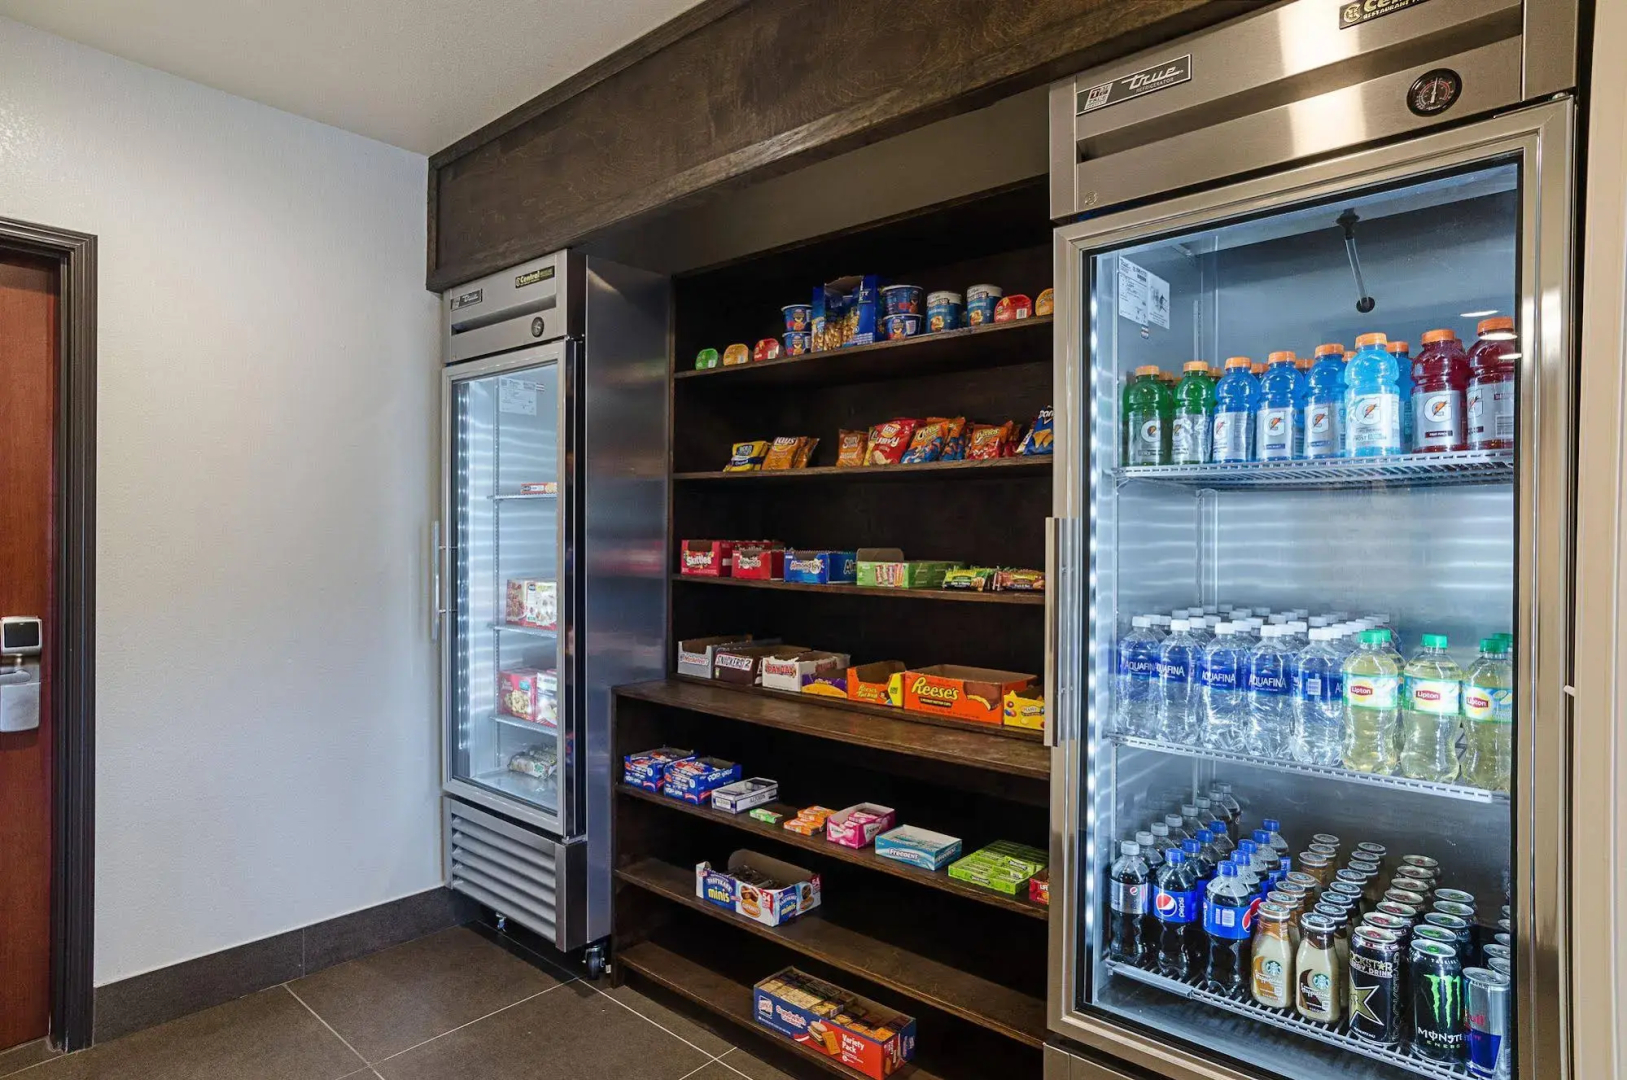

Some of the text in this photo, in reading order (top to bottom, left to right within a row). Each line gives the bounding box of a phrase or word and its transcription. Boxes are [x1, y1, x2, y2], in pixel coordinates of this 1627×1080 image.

[686, 555, 712, 566] Skittles
[1202, 670, 1236, 684] AQUAFINA
[1249, 674, 1287, 689] AQUAFINA
[911, 676, 959, 700] Reese's
[1351, 687, 1372, 695] Lipton
[1417, 691, 1439, 699] Lipton
[1467, 697, 1487, 707] Lipton
[842, 1033, 865, 1051] Variety
[842, 1041, 857, 1054] Pack
